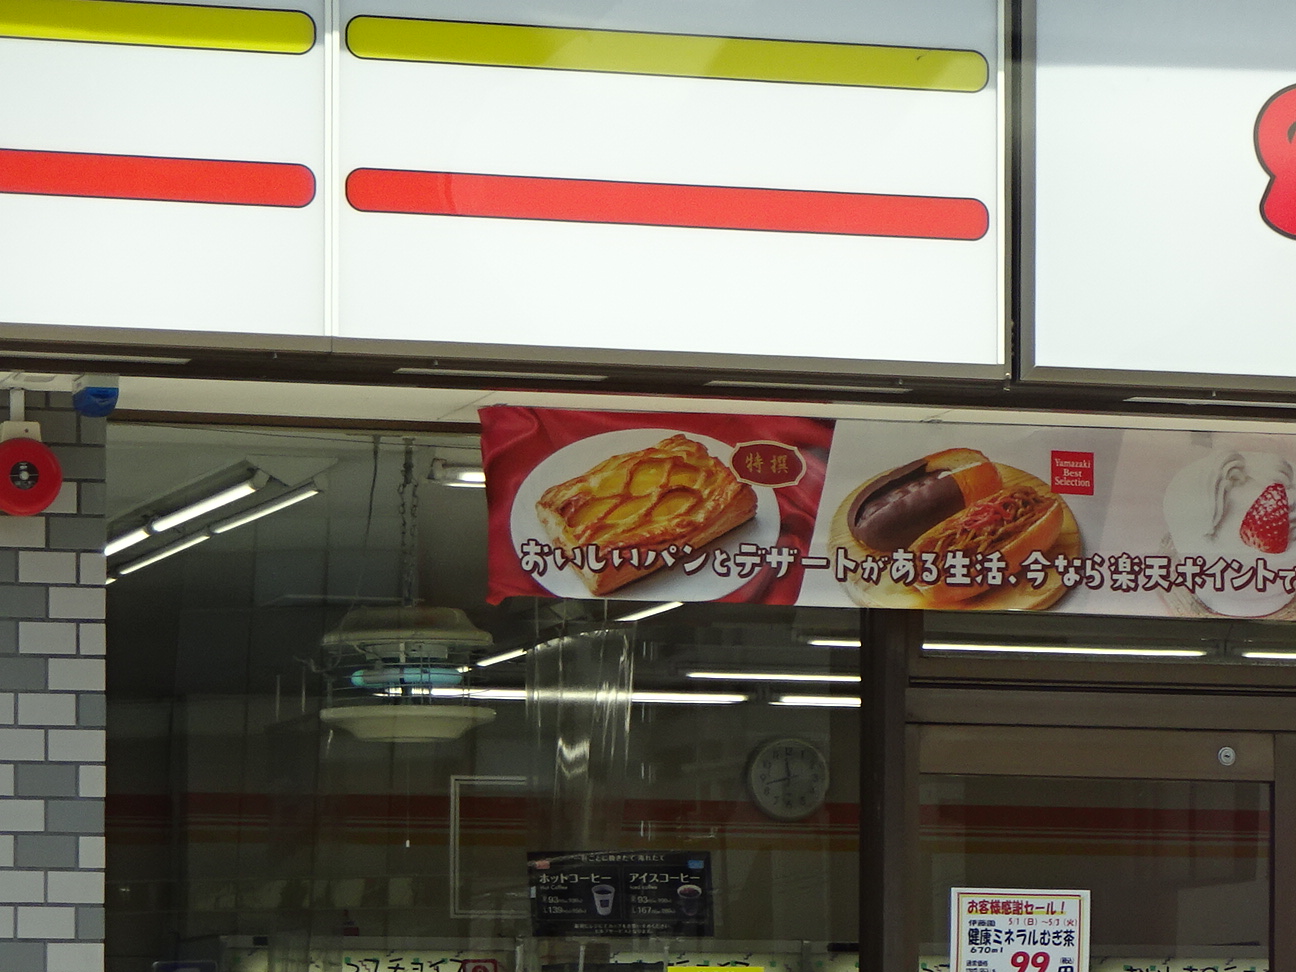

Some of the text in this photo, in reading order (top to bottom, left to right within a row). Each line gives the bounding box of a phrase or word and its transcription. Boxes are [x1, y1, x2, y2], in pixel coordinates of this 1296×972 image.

[1054, 458, 1091, 469] Yamazaki
[1063, 469, 1083, 478] Best
[1054, 477, 1091, 488] Selection
[539, 873, 612, 884] ホットコーヒー
[629, 872, 700, 883] アイスコーヒー
[968, 928, 1076, 947] 健康ミネラルむぎ茶
